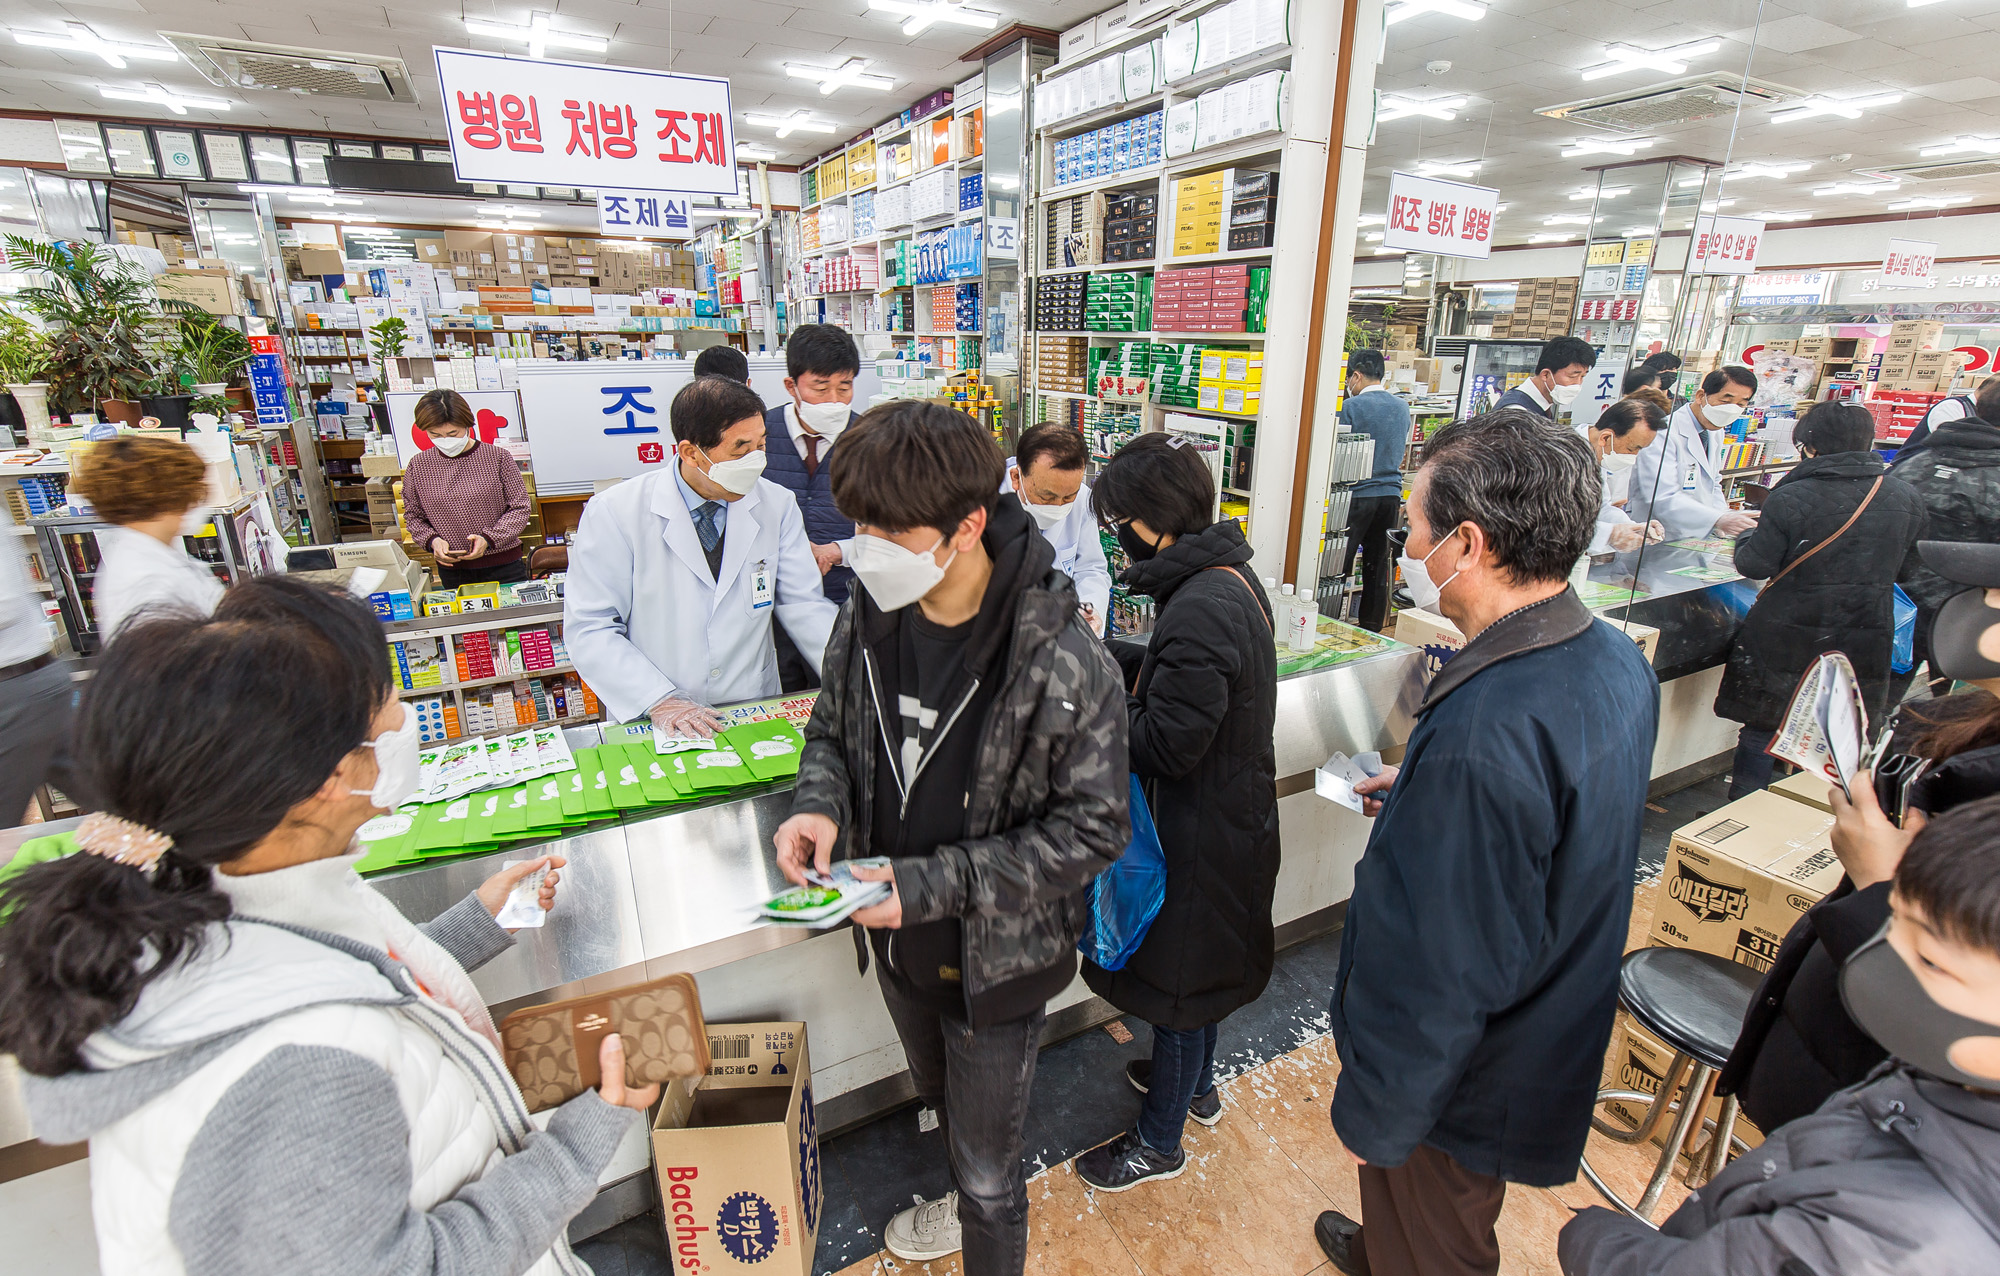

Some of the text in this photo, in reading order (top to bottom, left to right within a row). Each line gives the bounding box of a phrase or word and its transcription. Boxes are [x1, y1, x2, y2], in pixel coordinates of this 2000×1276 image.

[457, 90, 544, 153] 병원
[561, 99, 637, 159] 처방
[655, 109, 727, 167] 조제
[605, 196, 689, 228] 조제실
[601, 386, 660, 435] 조
[430, 605, 451, 615] 일반
[463, 598, 492, 611] 조제
[730, 704, 766, 718] 감기
[1669, 874, 1748, 920] 에프킬라
[1661, 921, 1689, 942] 30개입
[765, 1032, 794, 1041] 취급주의
[765, 1040, 794, 1050] 유리제품
[1127, 1157, 1151, 1175] N
[723, 1222, 740, 1237] D
[737, 1200, 766, 1256] 박카스
